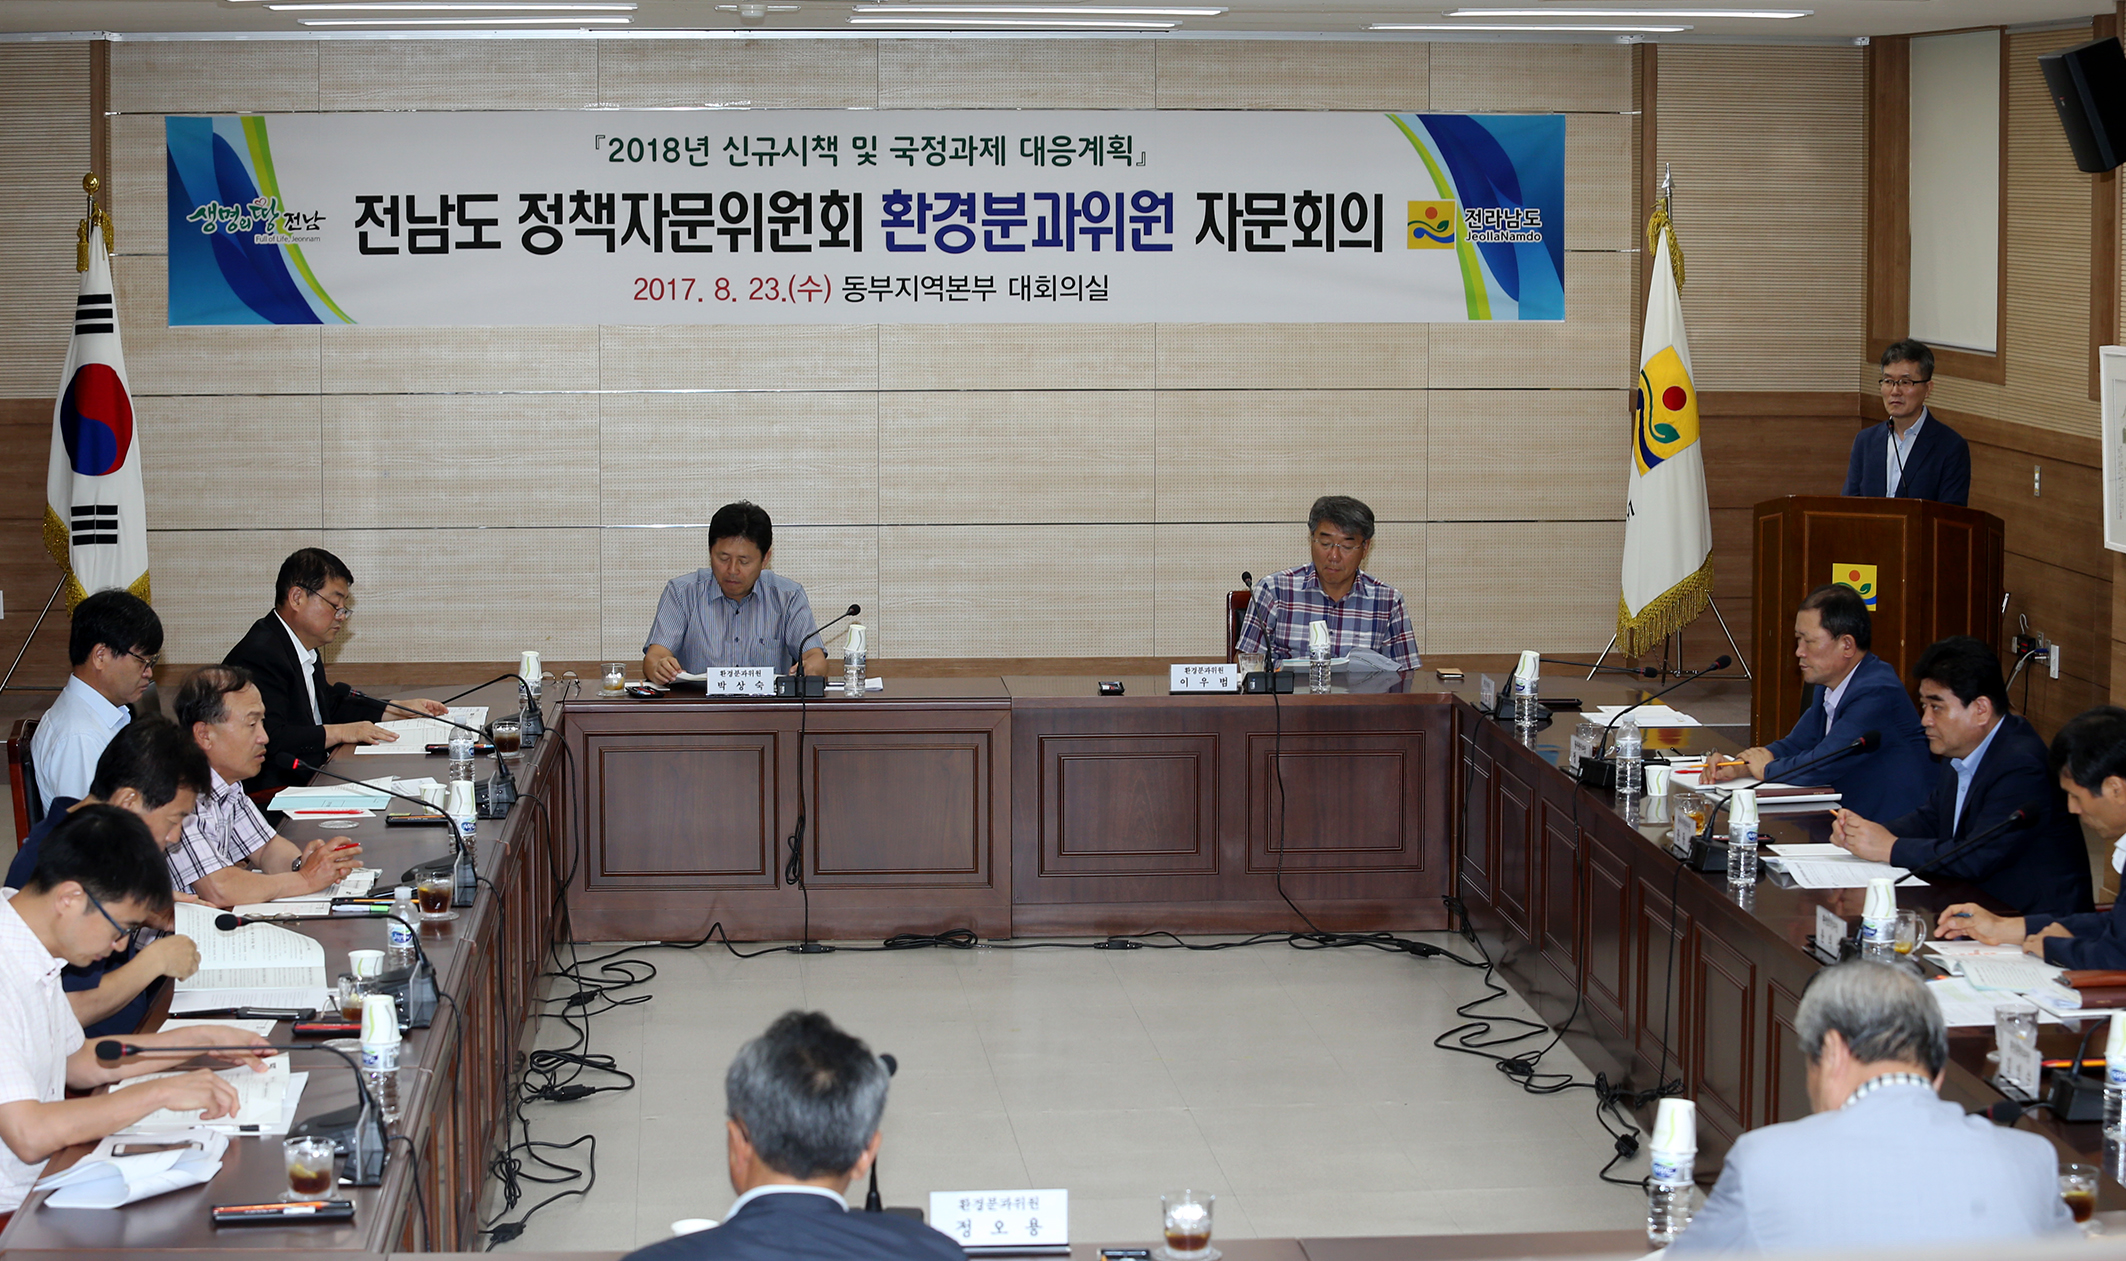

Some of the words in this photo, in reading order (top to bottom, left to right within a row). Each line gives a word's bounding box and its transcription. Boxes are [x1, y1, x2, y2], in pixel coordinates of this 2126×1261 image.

[722, 134, 838, 168] 신규시책
[851, 134, 878, 167] 및
[889, 134, 1006, 168] 국정과제
[187, 202, 252, 233] 생명의
[248, 198, 279, 232] 땅
[283, 210, 326, 231] 전남
[354, 193, 502, 256] 전남도
[518, 188, 863, 256] 정책자문위원회
[880, 188, 1174, 255] 환경분과위원
[1195, 189, 1384, 253] 자문회의
[1464, 209, 1542, 229] 전라남도
[256, 235, 269, 243] Full
[291, 235, 321, 243] Jeonnam
[1465, 231, 1542, 242] JeollaNamdo
[633, 277, 704, 303] 2017.
[714, 276, 737, 303] 8.
[748, 273, 832, 305] 23.(수)
[841, 274, 998, 304] 동부지역본부
[1007, 274, 1109, 303] 대회의실
[719, 669, 762, 678] 환경분과위원
[1184, 666, 1224, 674] 환경분과위원
[959, 1196, 1039, 1211] 환경분과위원
